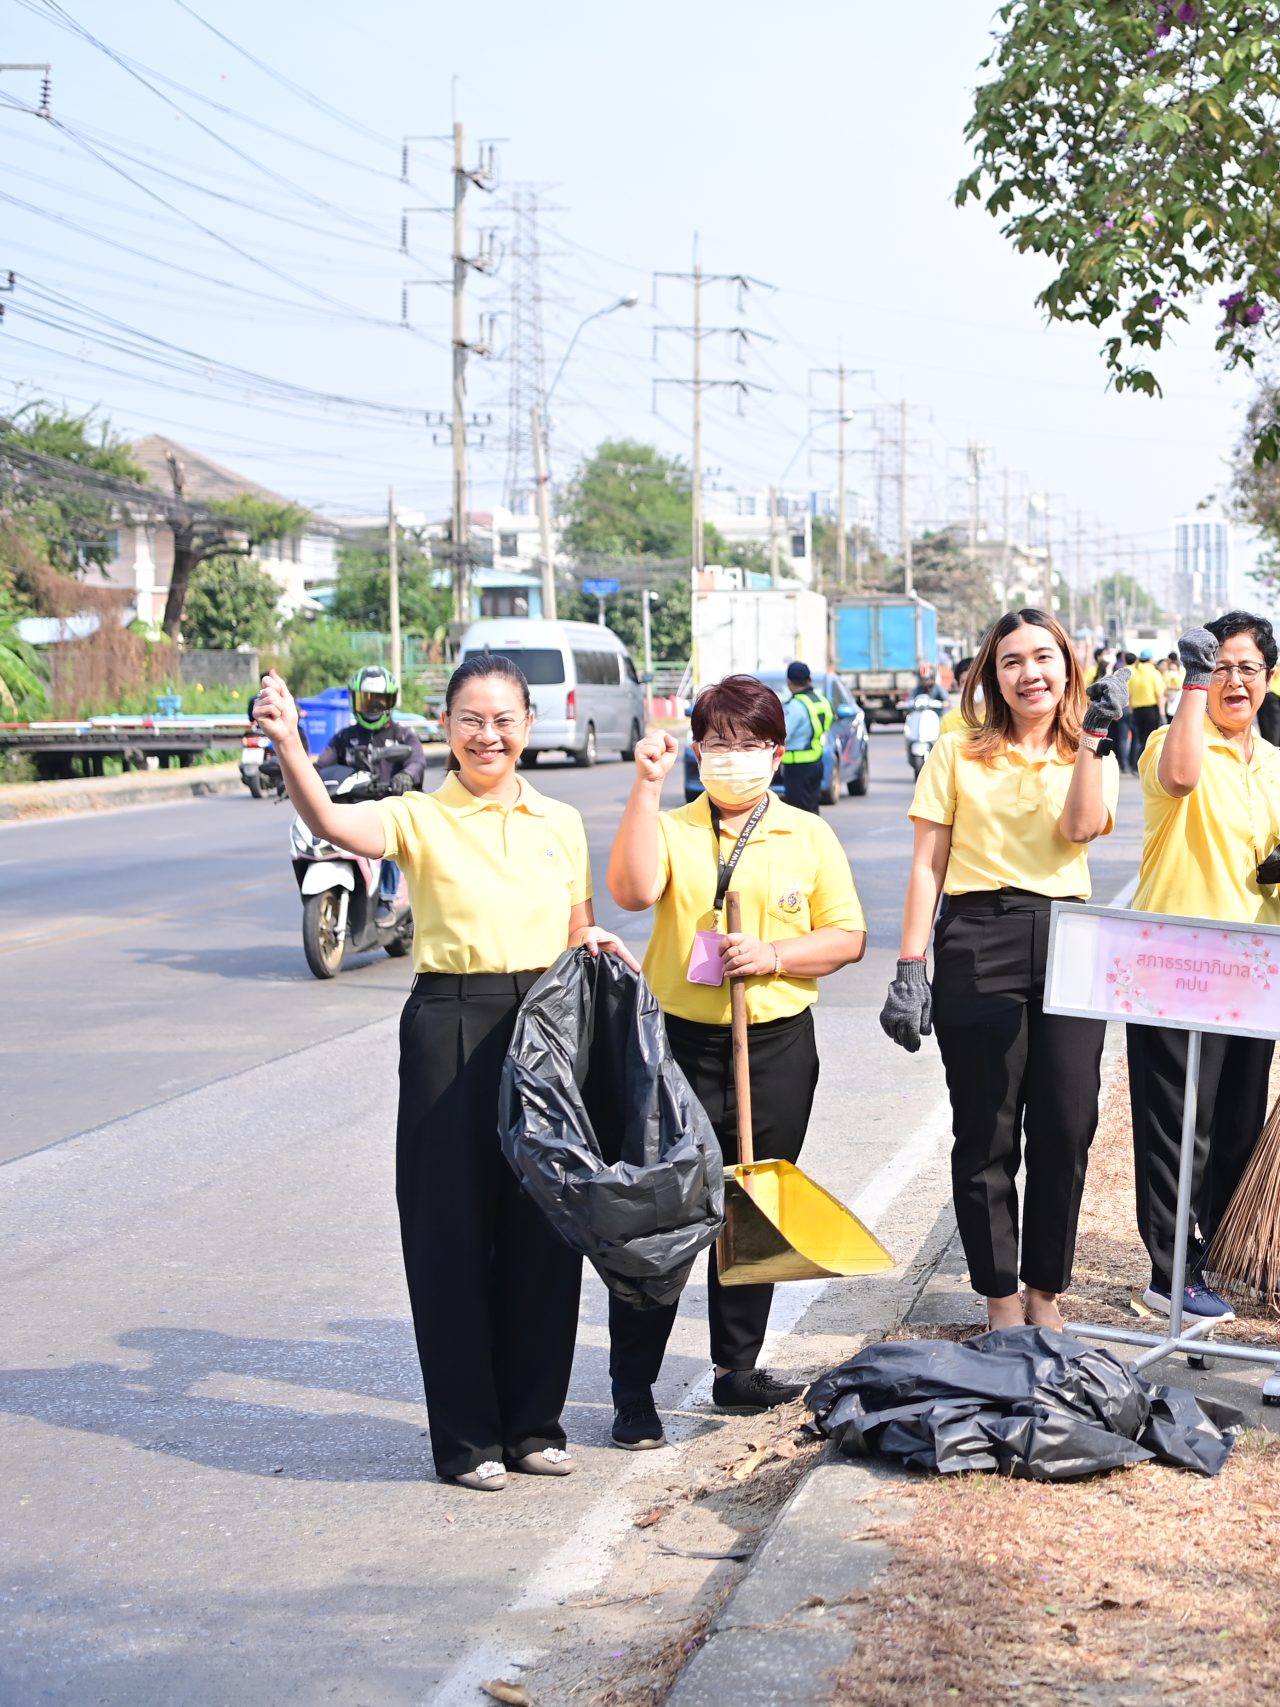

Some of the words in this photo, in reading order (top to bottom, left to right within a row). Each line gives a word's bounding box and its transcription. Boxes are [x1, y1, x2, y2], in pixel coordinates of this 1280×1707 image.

[728, 848, 742, 867] MWA
[737, 837, 747, 847] CG
[742, 820, 757, 837] SMILE
[1136, 954, 1250, 978] สภาธรรมาภิบาล
